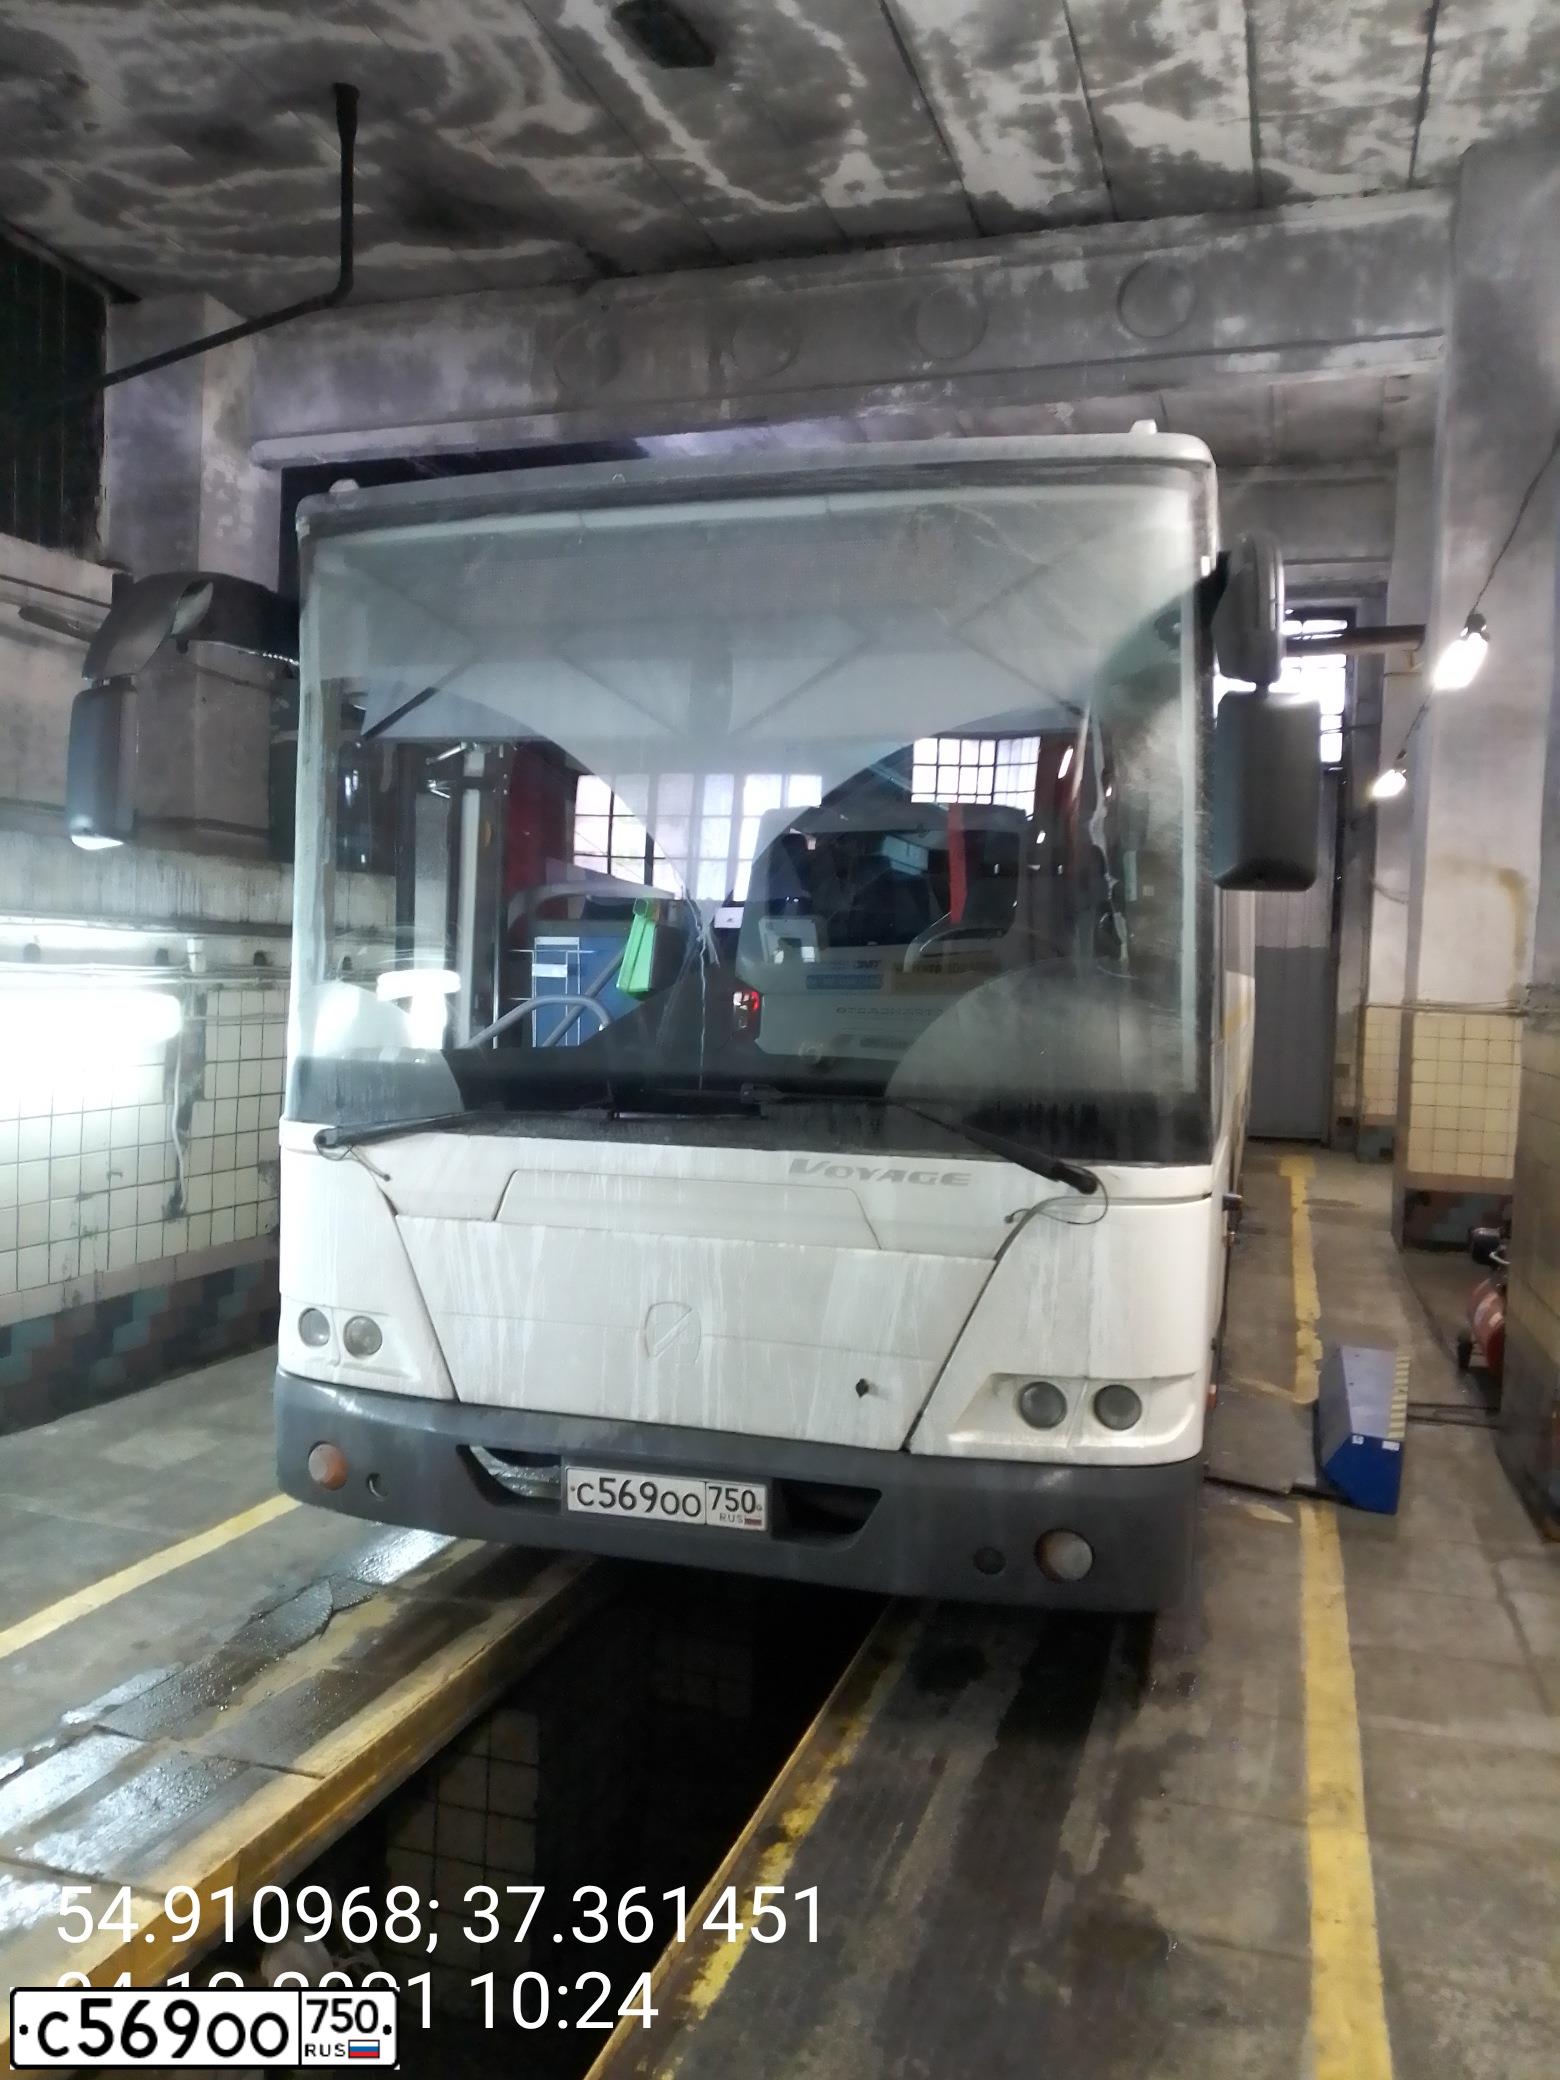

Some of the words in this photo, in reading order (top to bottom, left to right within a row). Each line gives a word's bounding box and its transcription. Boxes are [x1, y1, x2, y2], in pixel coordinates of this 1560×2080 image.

[788, 1157, 973, 1187] VOYAGE
[708, 1486, 756, 1514] 750
[719, 1512, 744, 1524] RUS
